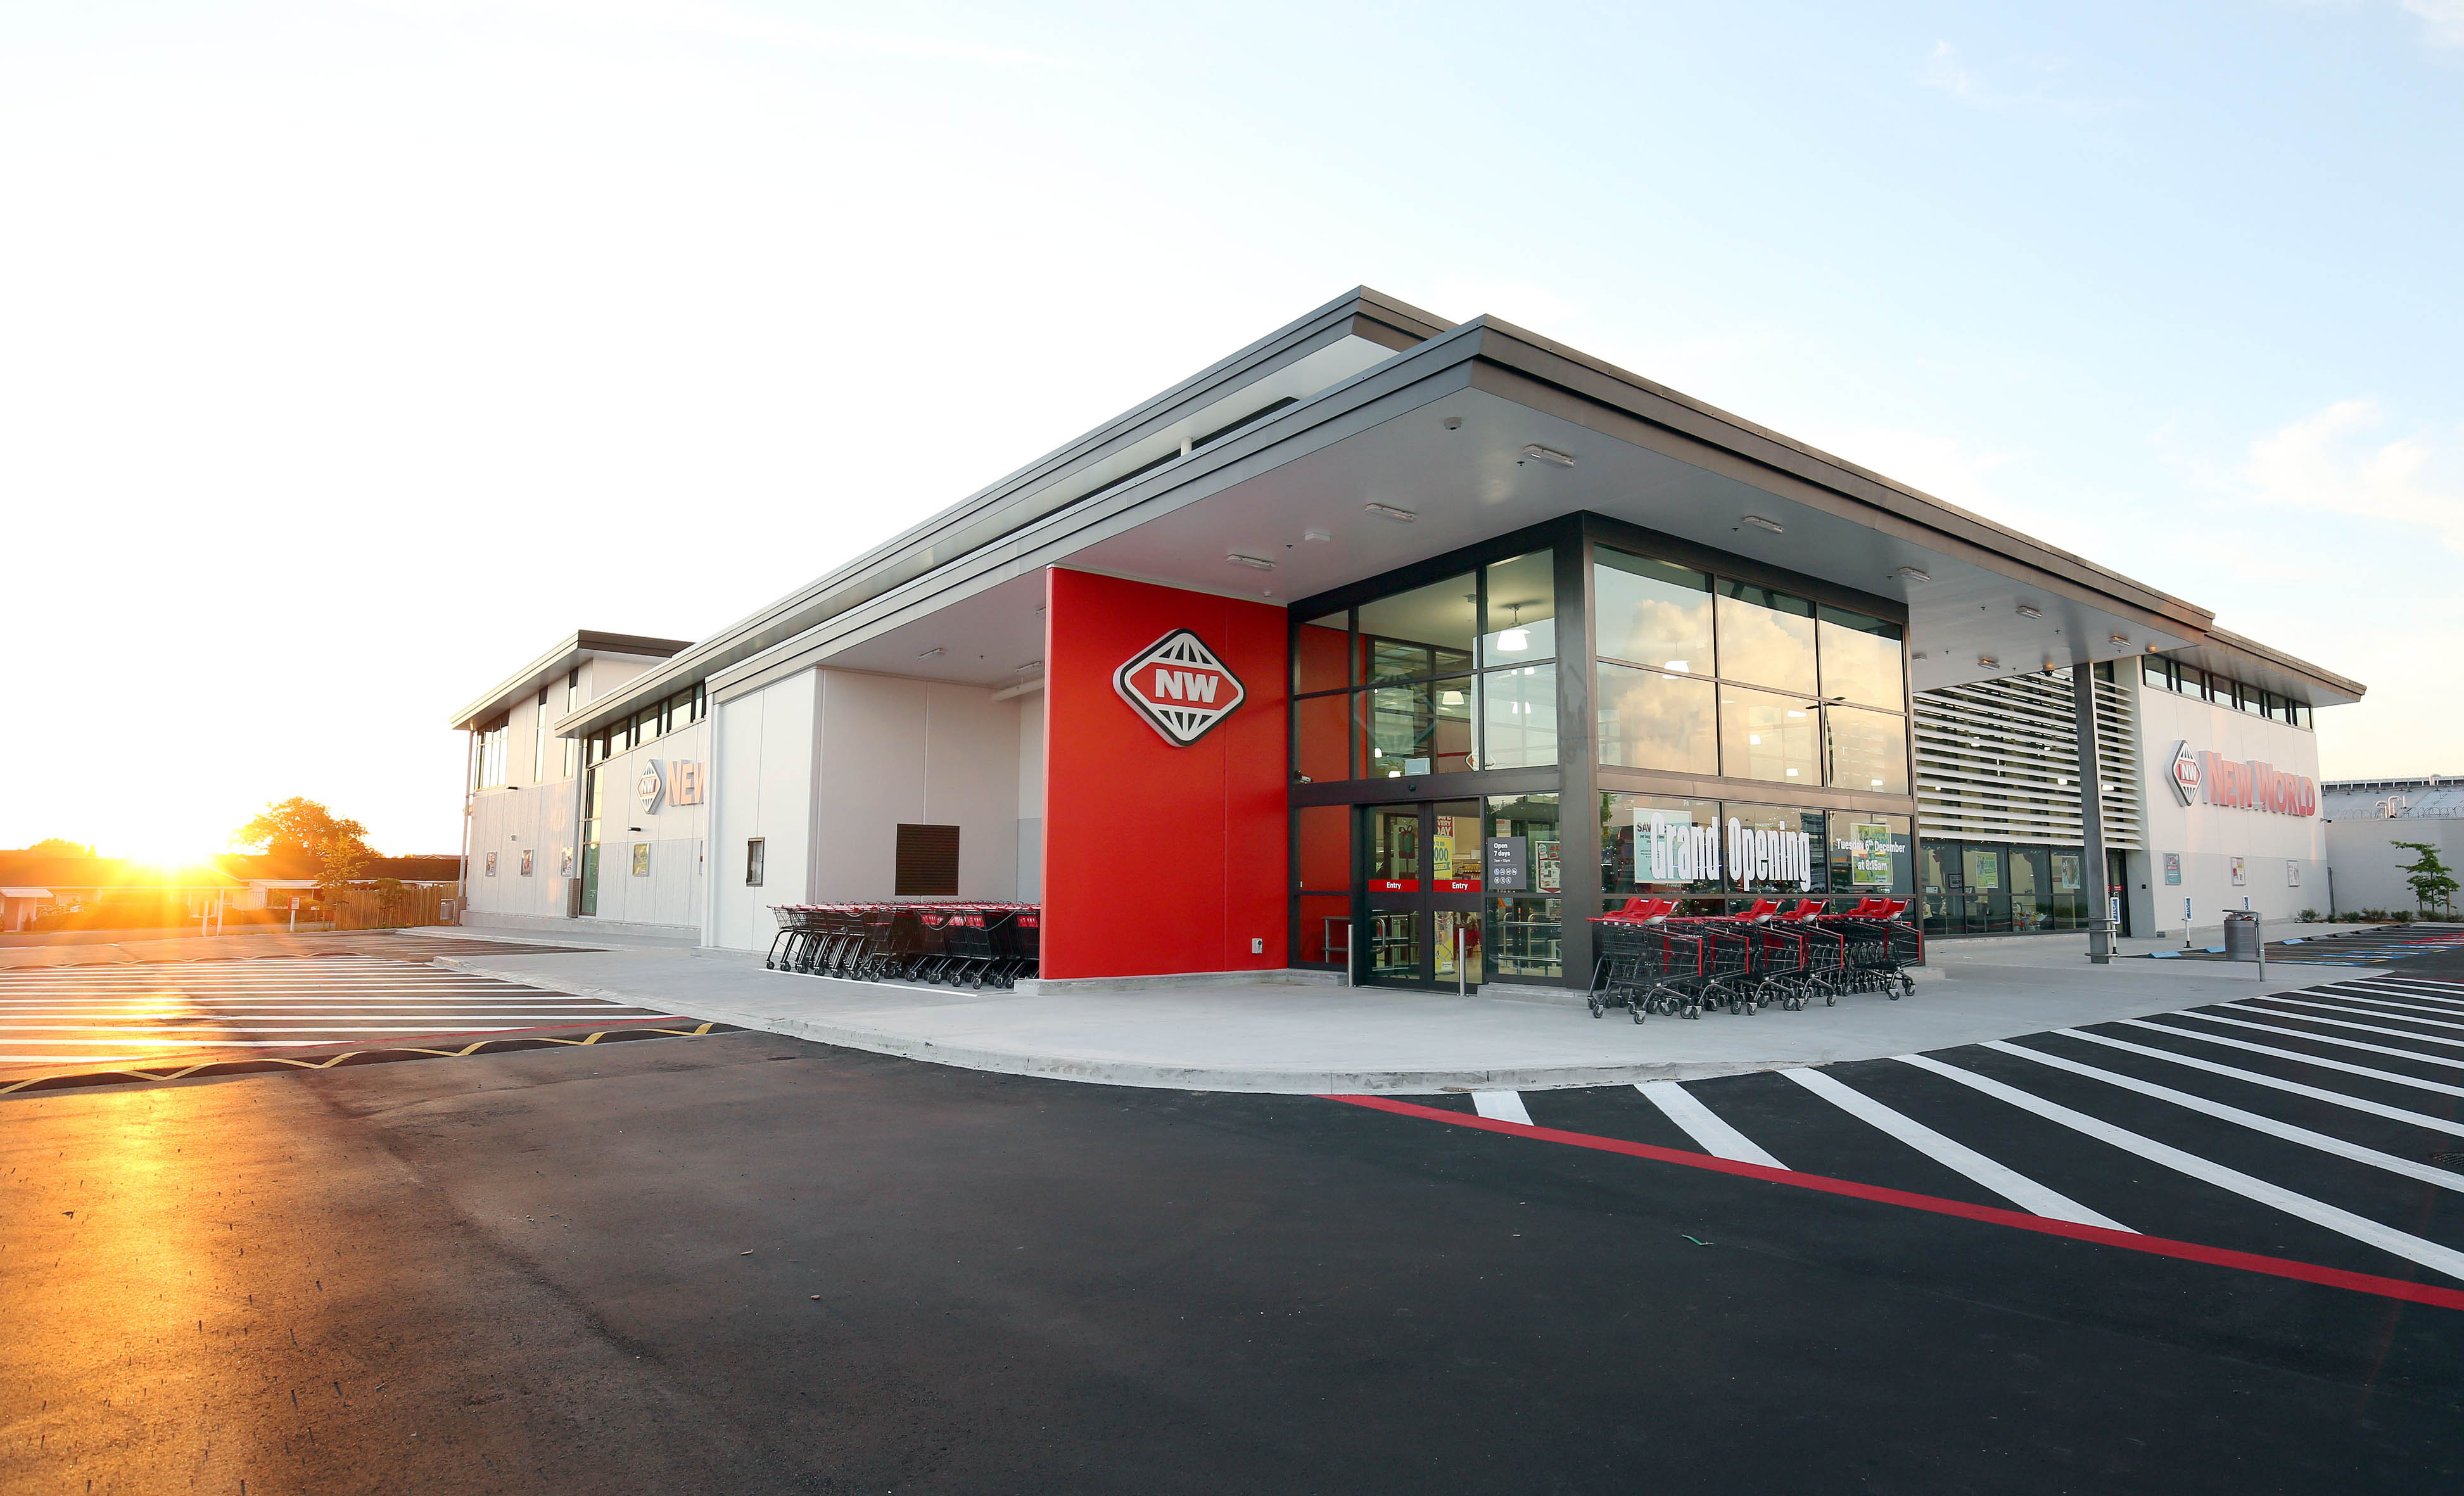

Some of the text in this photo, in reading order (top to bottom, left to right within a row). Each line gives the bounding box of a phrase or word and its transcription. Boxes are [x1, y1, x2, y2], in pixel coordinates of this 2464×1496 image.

[1155, 668, 1219, 703] NW
[2179, 763, 2197, 782] NW
[642, 779, 656, 794] NW
[2200, 751, 2316, 816] NEW WORLD
[1637, 821, 1651, 832] SAV
[1650, 812, 1812, 892] Grand Opening
[1836, 838, 1864, 850] Tuesday
[1865, 839, 1874, 851] 6th
[1874, 840, 1905, 853] December
[1434, 847, 1449, 861] 000
[1857, 859, 1888, 871] at 8:15am
[1386, 882, 1401, 890] Entry
[1452, 882, 1468, 890] Entry
